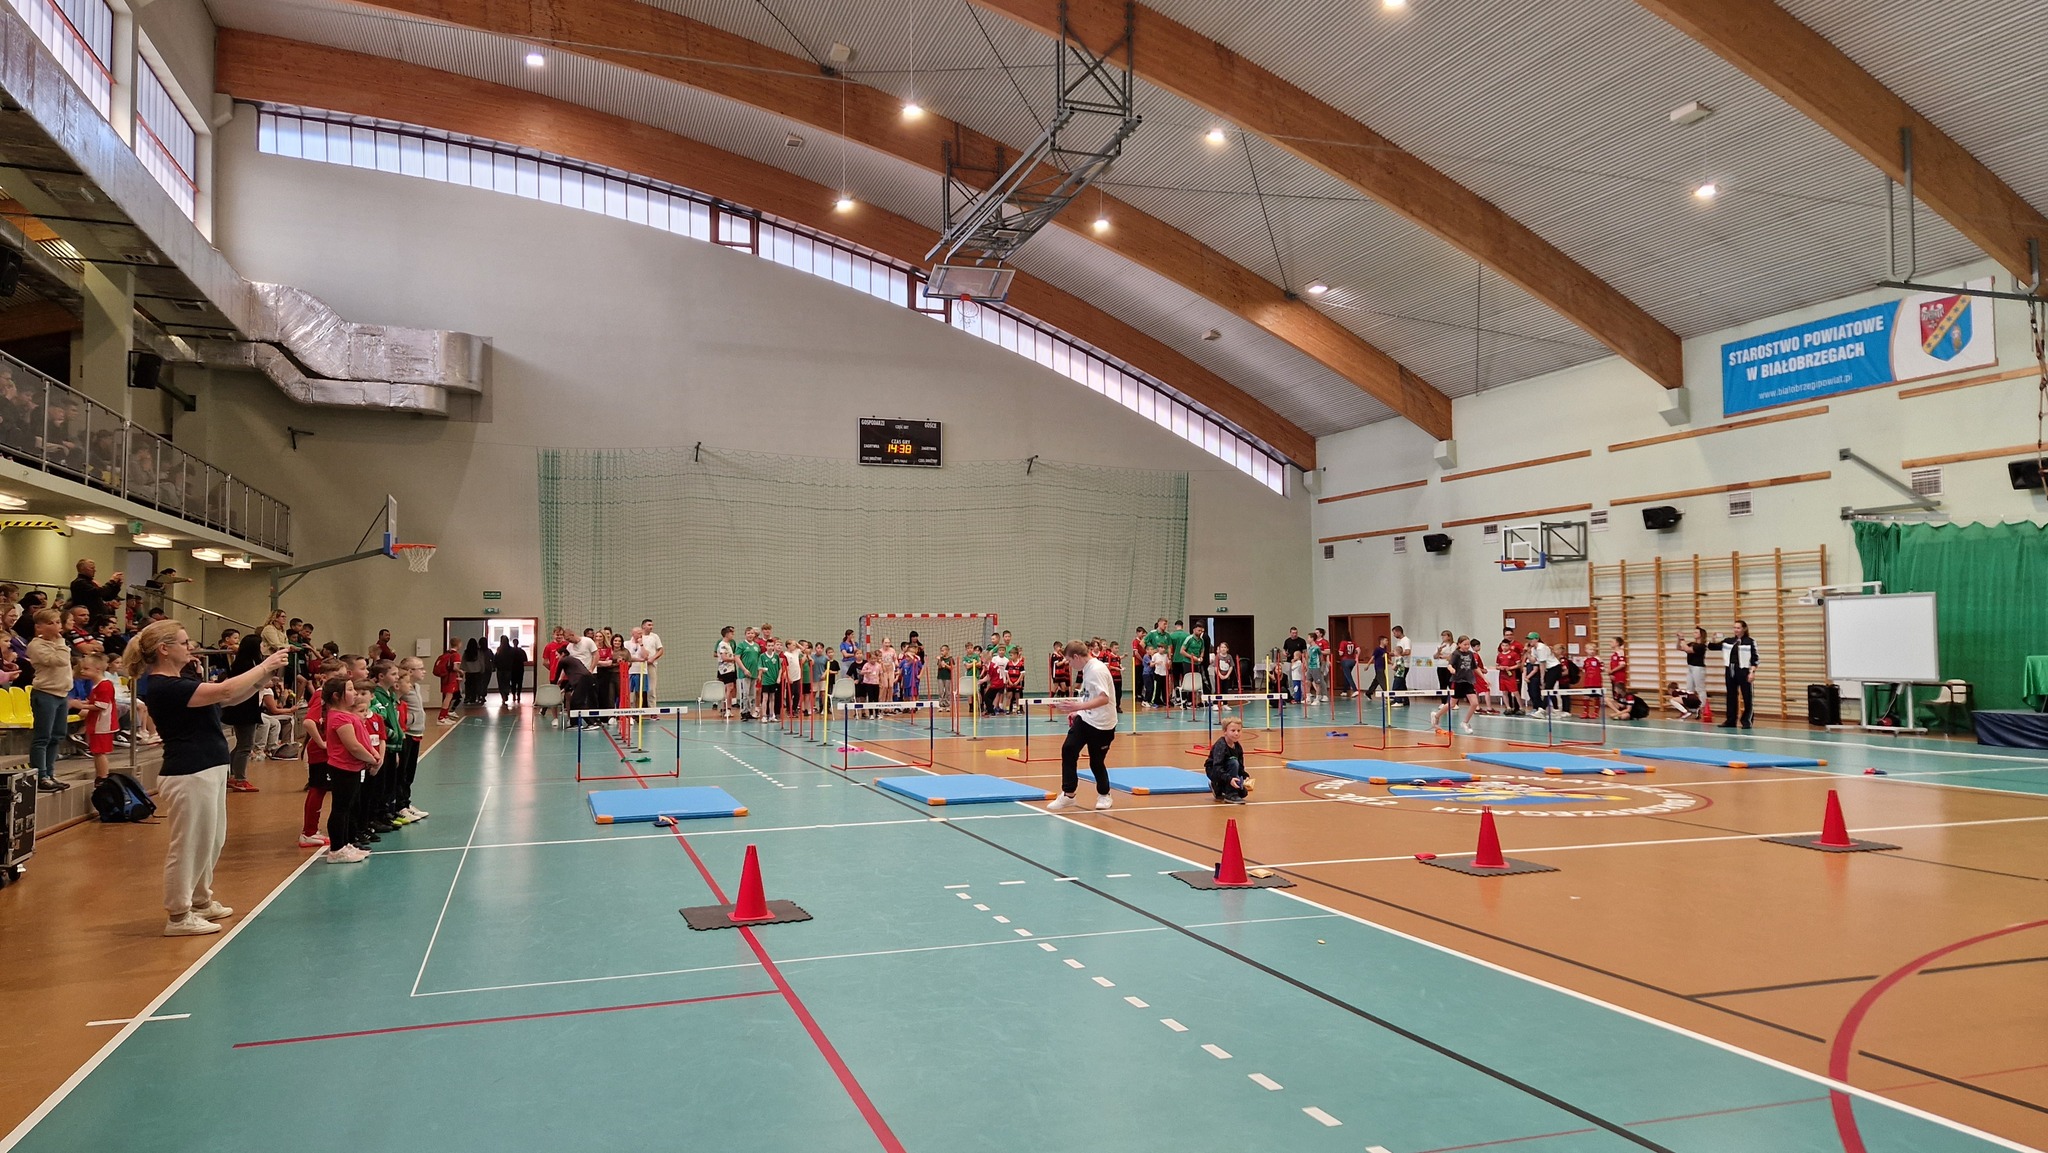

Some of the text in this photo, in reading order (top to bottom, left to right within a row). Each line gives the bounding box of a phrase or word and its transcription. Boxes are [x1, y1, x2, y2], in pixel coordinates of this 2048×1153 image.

[1728, 315, 1884, 366] STAROSTWO POWIATOWE
[1746, 341, 1865, 381] W BIAŁOBRZEGACH
[887, 444, 912, 453] 14:38
